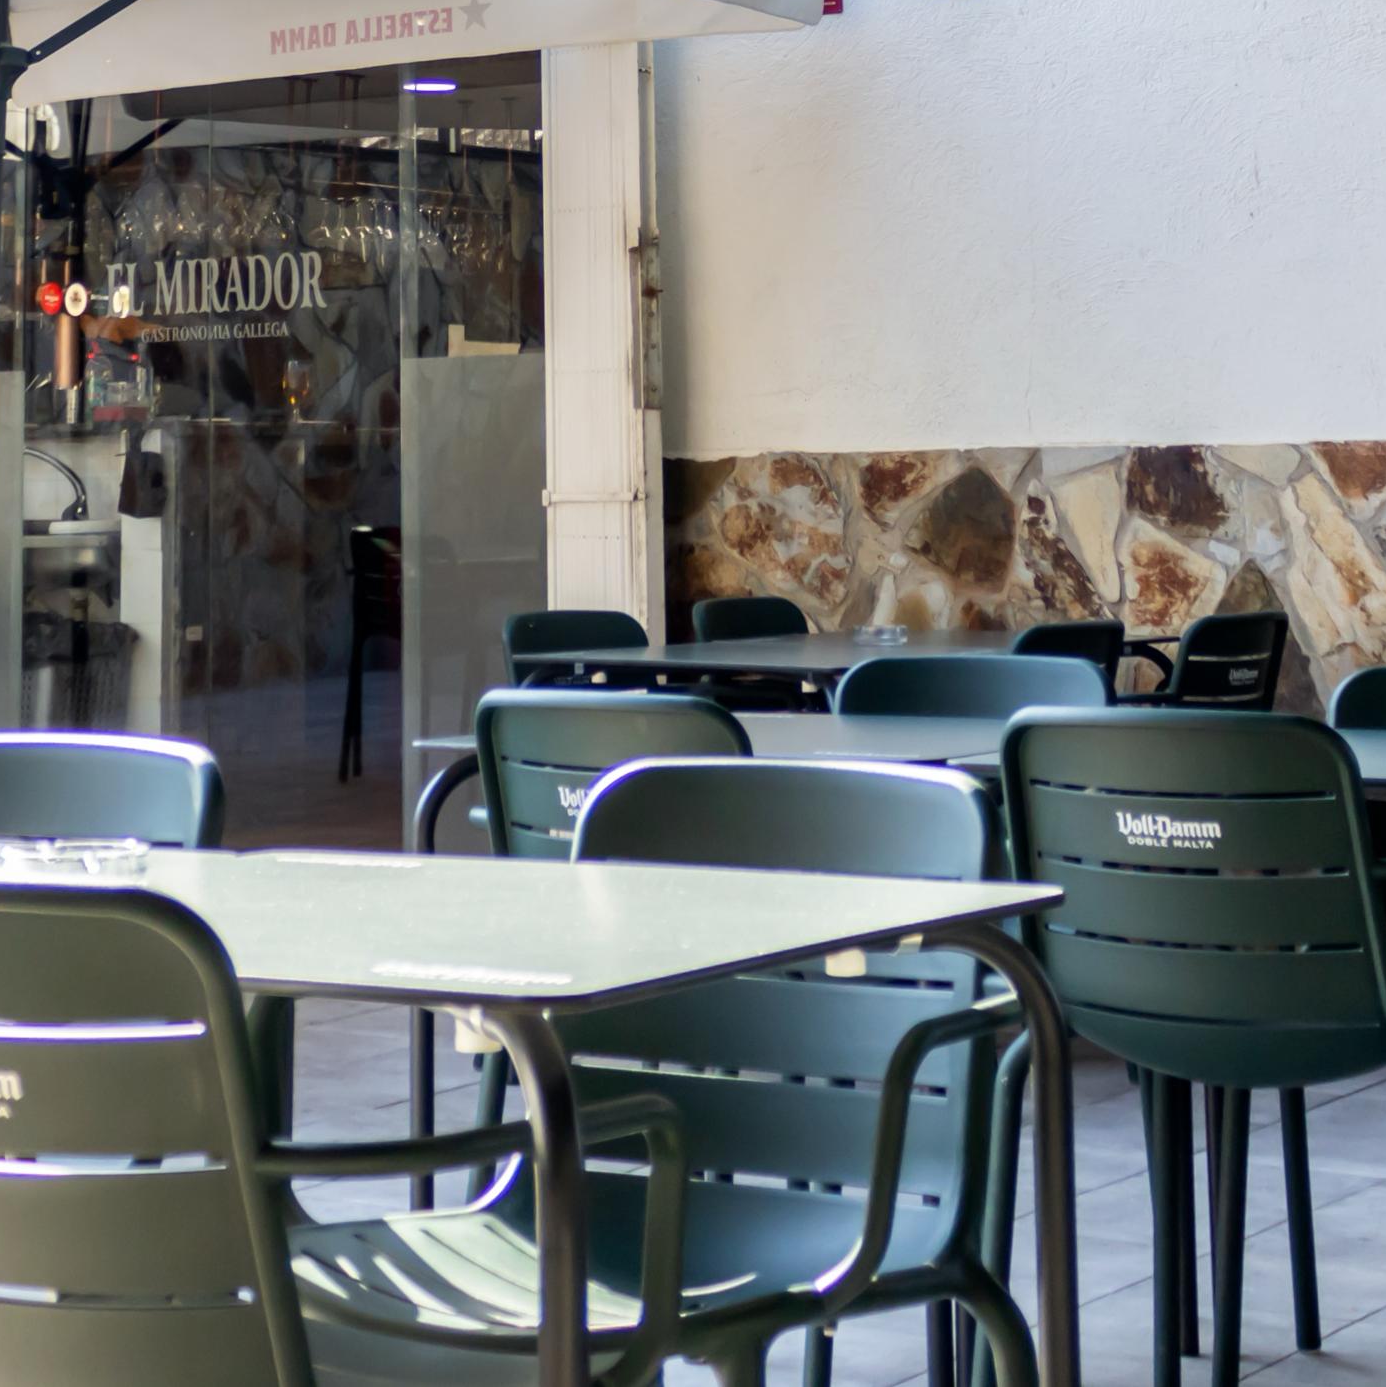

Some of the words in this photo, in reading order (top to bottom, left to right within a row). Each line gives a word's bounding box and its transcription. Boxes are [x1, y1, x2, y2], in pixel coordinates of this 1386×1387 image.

[104, 262, 146, 319] EL
[153, 251, 327, 316] MIRADOR
[233, 321, 290, 339] GALLEGA
[1115, 811, 1222, 839] Voll-Damm
[1126, 836, 1169, 848] DOBLE
[1172, 839, 1215, 850] MALTA
